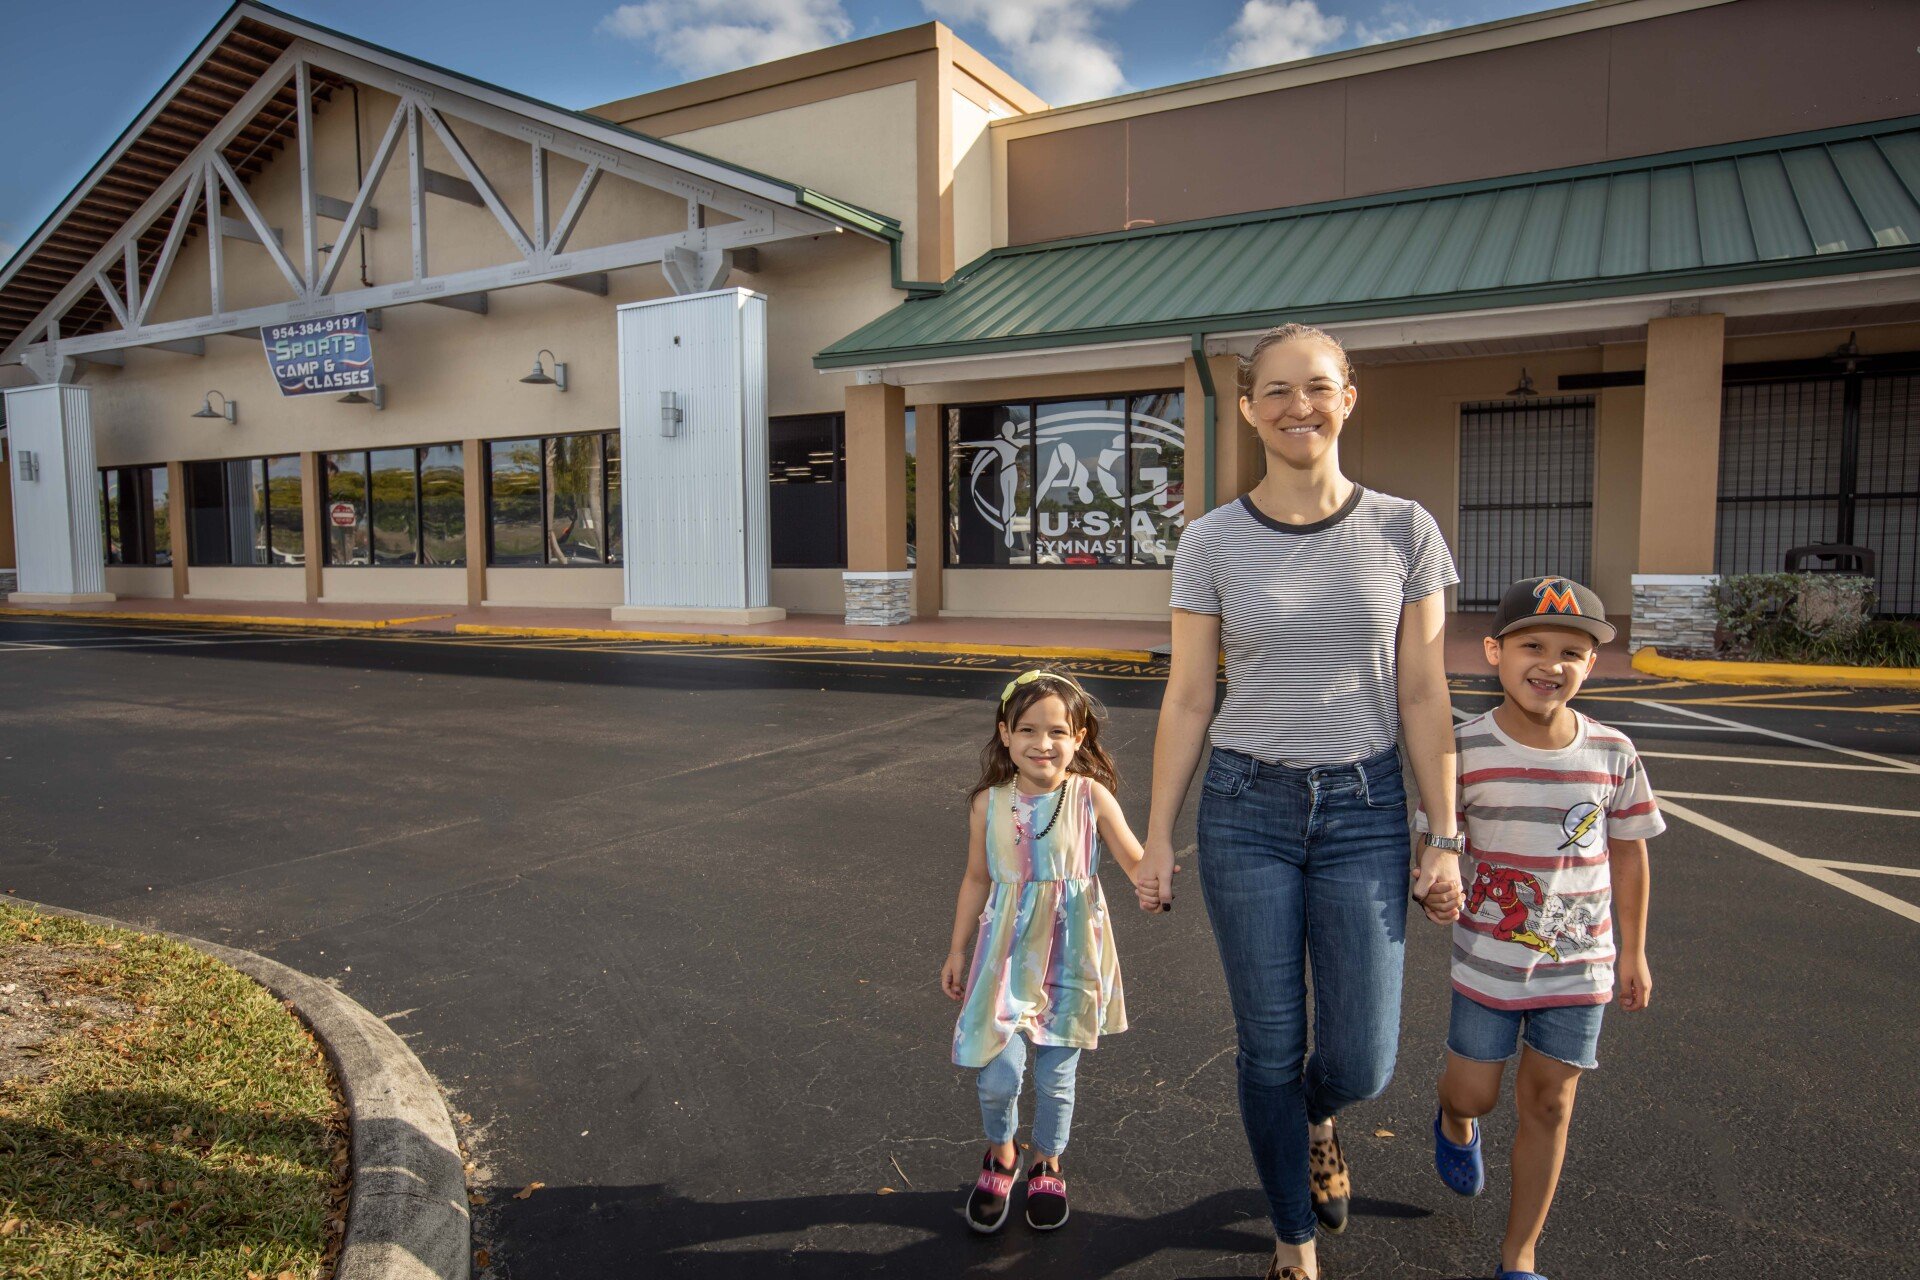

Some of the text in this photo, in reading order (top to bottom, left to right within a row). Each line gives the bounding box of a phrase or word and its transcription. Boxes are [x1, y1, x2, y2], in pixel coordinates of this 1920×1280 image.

[272, 317, 357, 339] 954-384-9191
[275, 334, 356, 361] SPORTS
[276, 359, 335, 378] CAMP &
[304, 370, 369, 389] CLASSES
[1035, 539, 1166, 555] GYMNASTICS
[1533, 580, 1583, 614] M
[939, 657, 997, 665] NO
